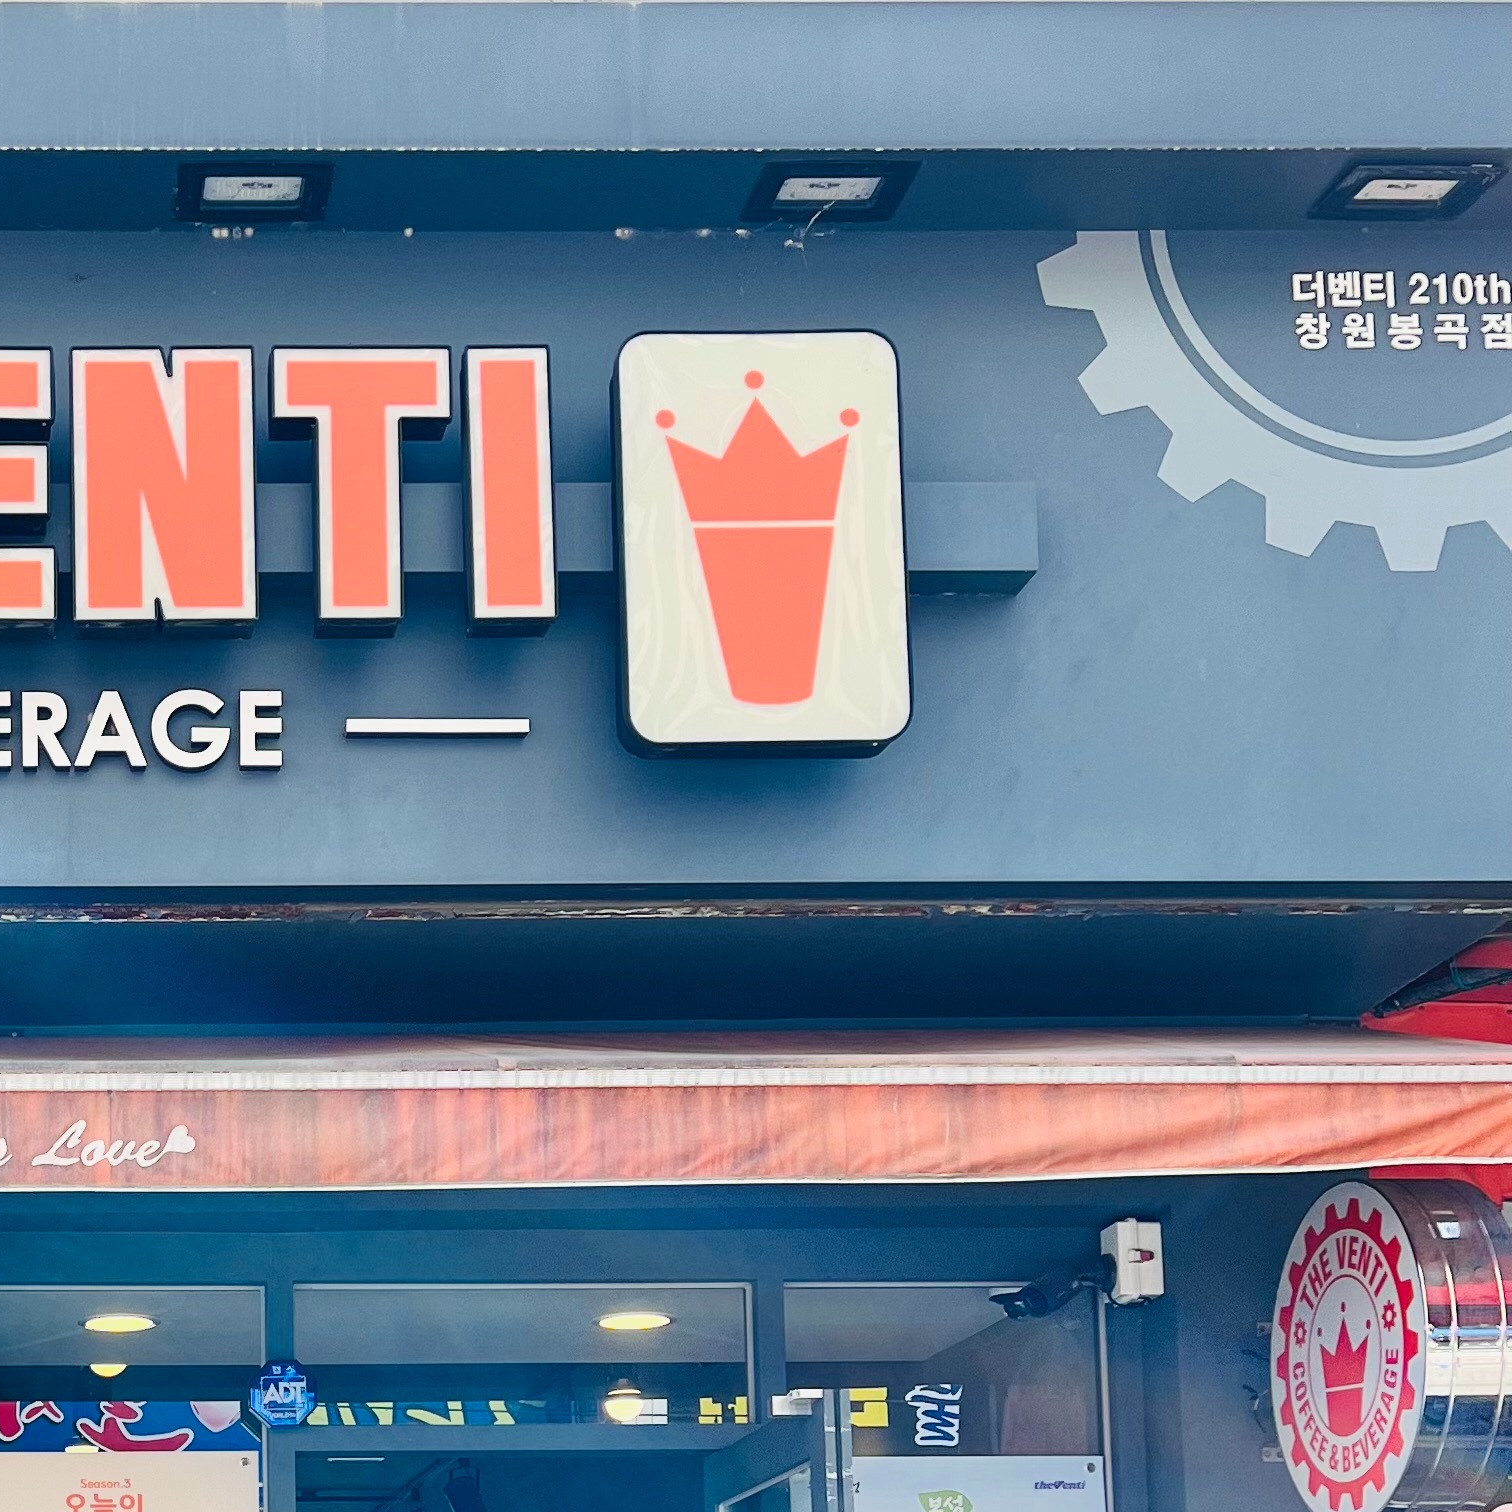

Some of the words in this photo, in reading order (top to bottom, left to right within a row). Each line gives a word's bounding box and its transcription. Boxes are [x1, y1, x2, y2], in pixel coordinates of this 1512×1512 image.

[1291, 270, 1396, 309] 더벤티
[1408, 272, 1512, 306] 210th
[30, 1118, 170, 1168] Love
[1299, 1250, 1334, 1311] THE
[1335, 1235, 1388, 1298] VENTI
[263, 1381, 306, 1405] ADT
[1293, 1361, 1329, 1462] COFFEE
[1329, 1449, 1340, 1472] &
[1342, 1347, 1400, 1473] BEVERAGE
[80, 1477, 132, 1490] Season.3
